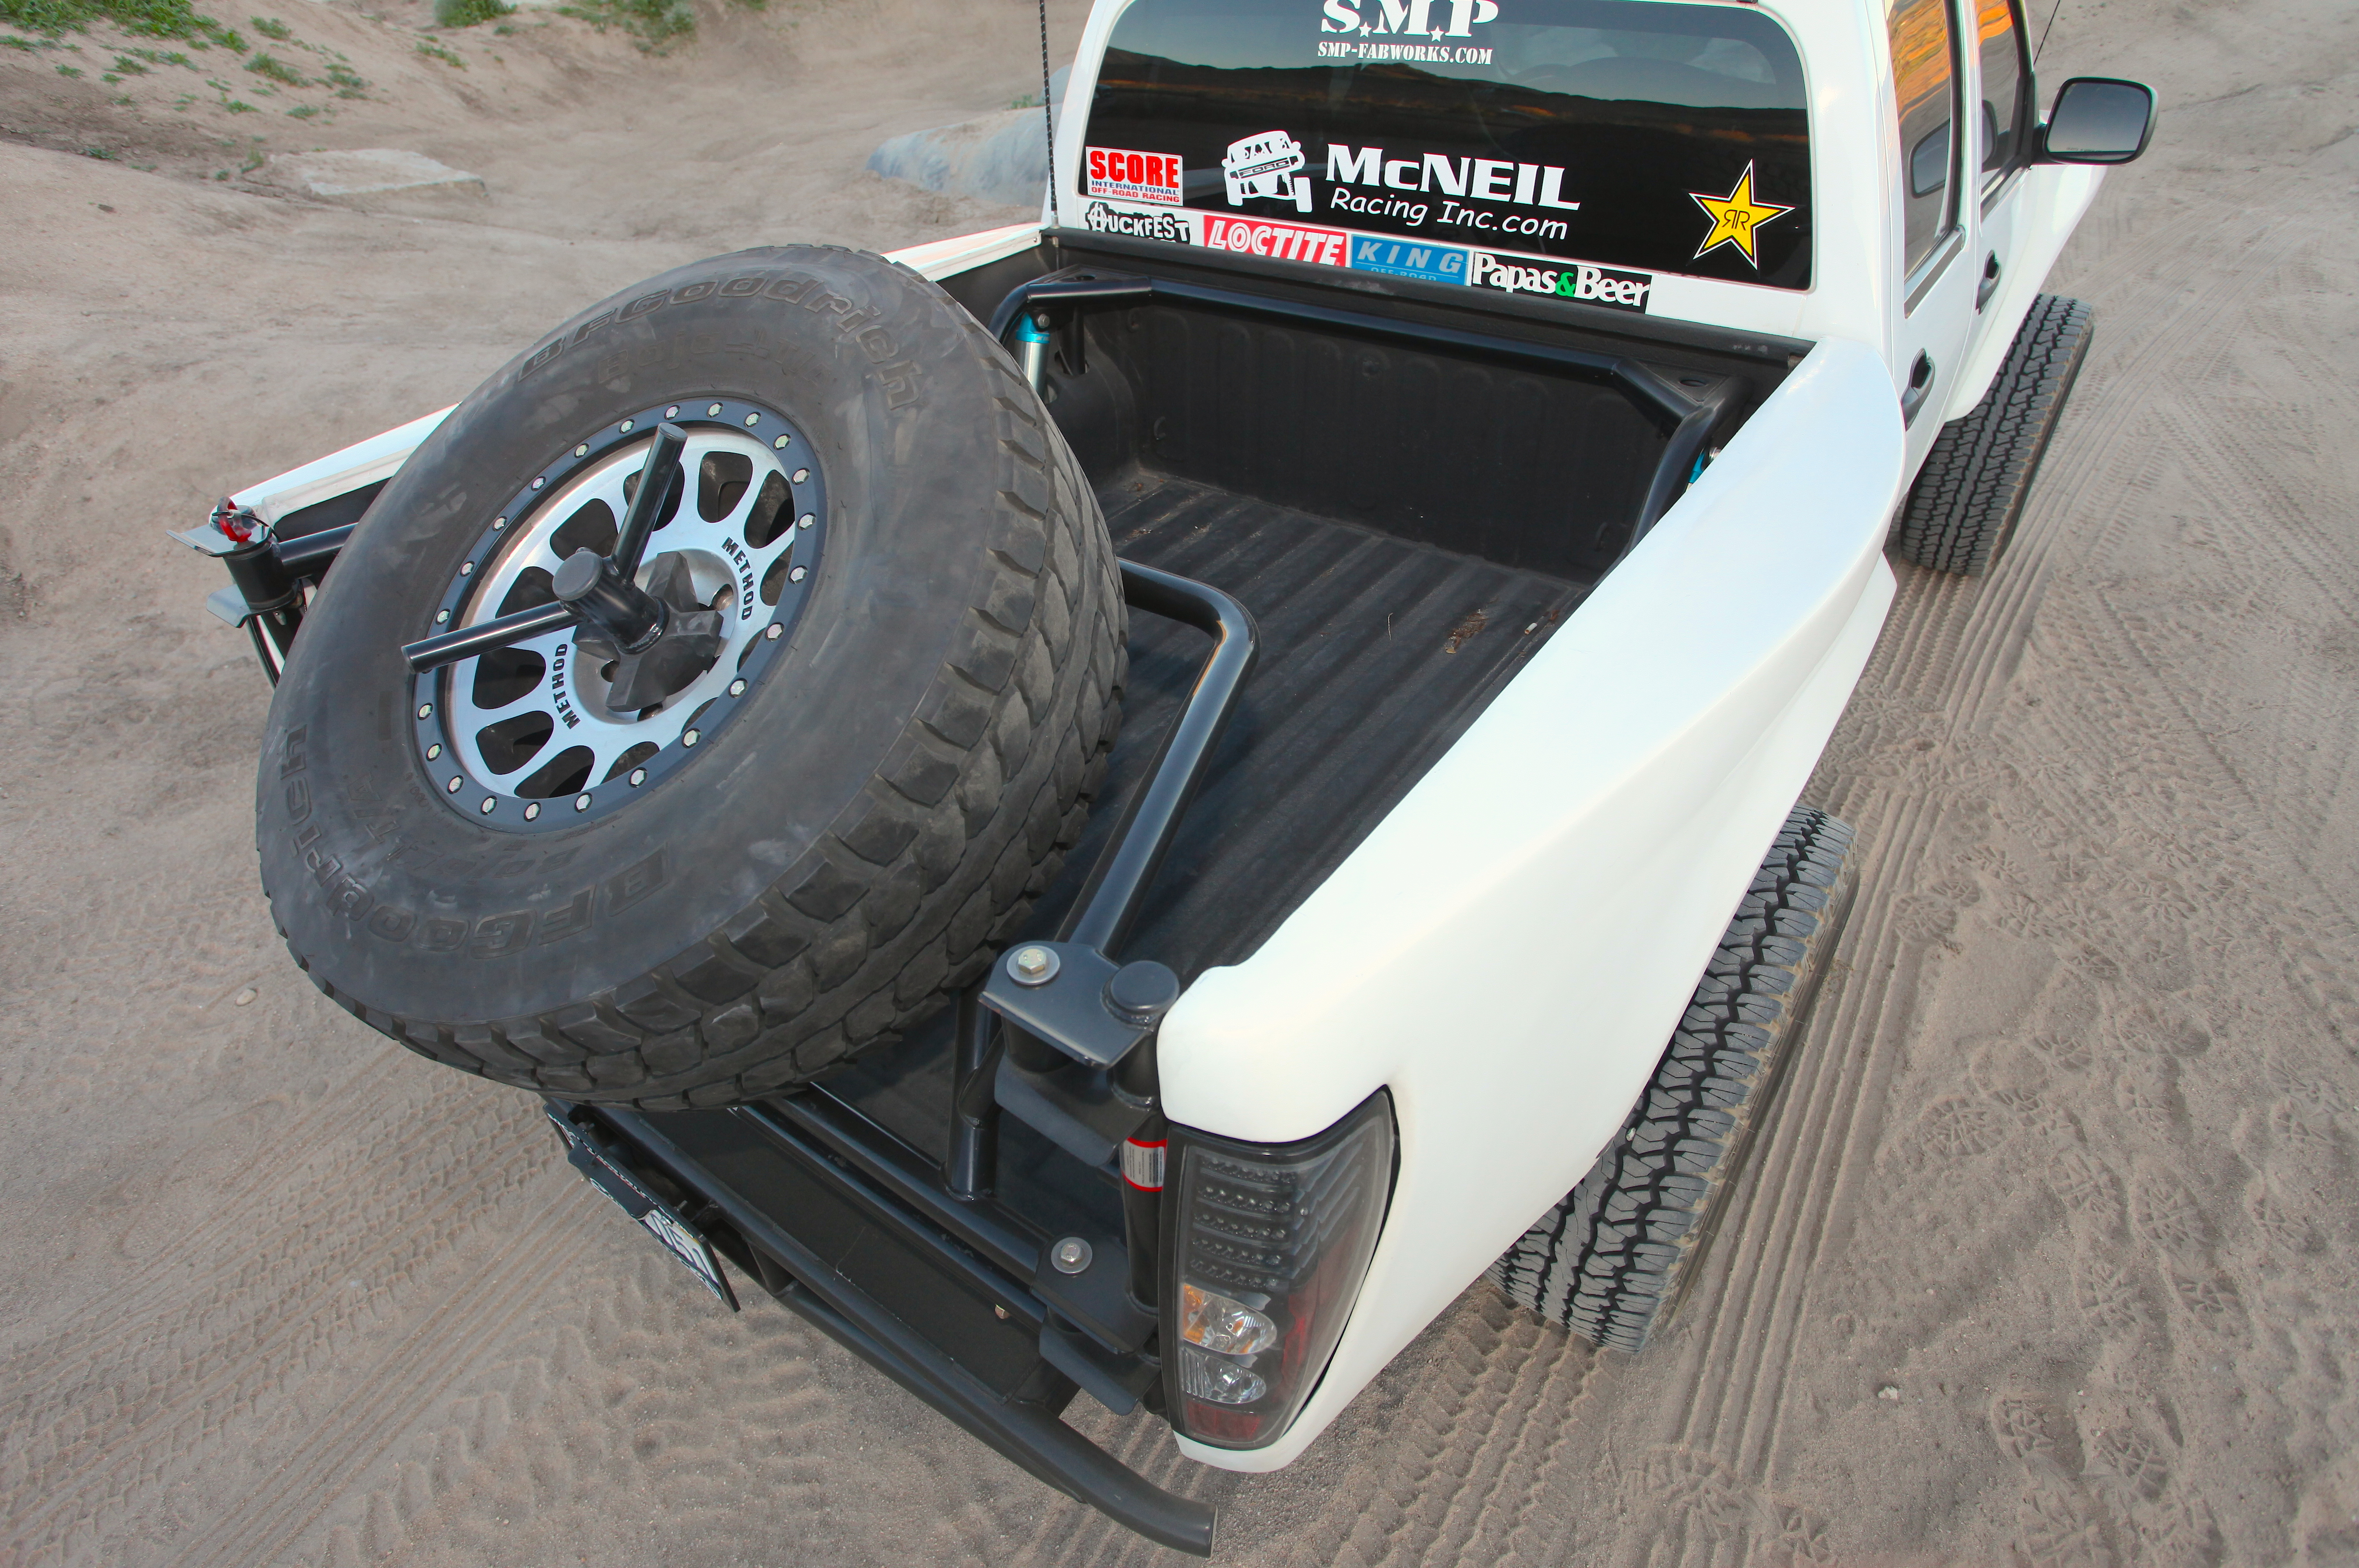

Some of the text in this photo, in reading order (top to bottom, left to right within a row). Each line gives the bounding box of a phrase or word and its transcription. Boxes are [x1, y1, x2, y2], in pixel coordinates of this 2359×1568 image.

[1318, 41, 1493, 65] SMP-FABWORKS.COM
[1090, 150, 1179, 189] SCORE
[1091, 180, 1179, 196] INTERNATIONAL
[1238, 160, 1289, 176] FORD
[1325, 143, 1581, 211] McNEIL
[1091, 186, 1180, 203] OFF-ROAD RACING
[1330, 187, 1568, 240] Racing Inc.com
[1207, 220, 1344, 266] LOCTITE
[1357, 241, 1464, 274] KING
[518, 275, 925, 410] BFGoodrich
[721, 536, 754, 621] METHOD
[551, 643, 581, 730] METHOD
